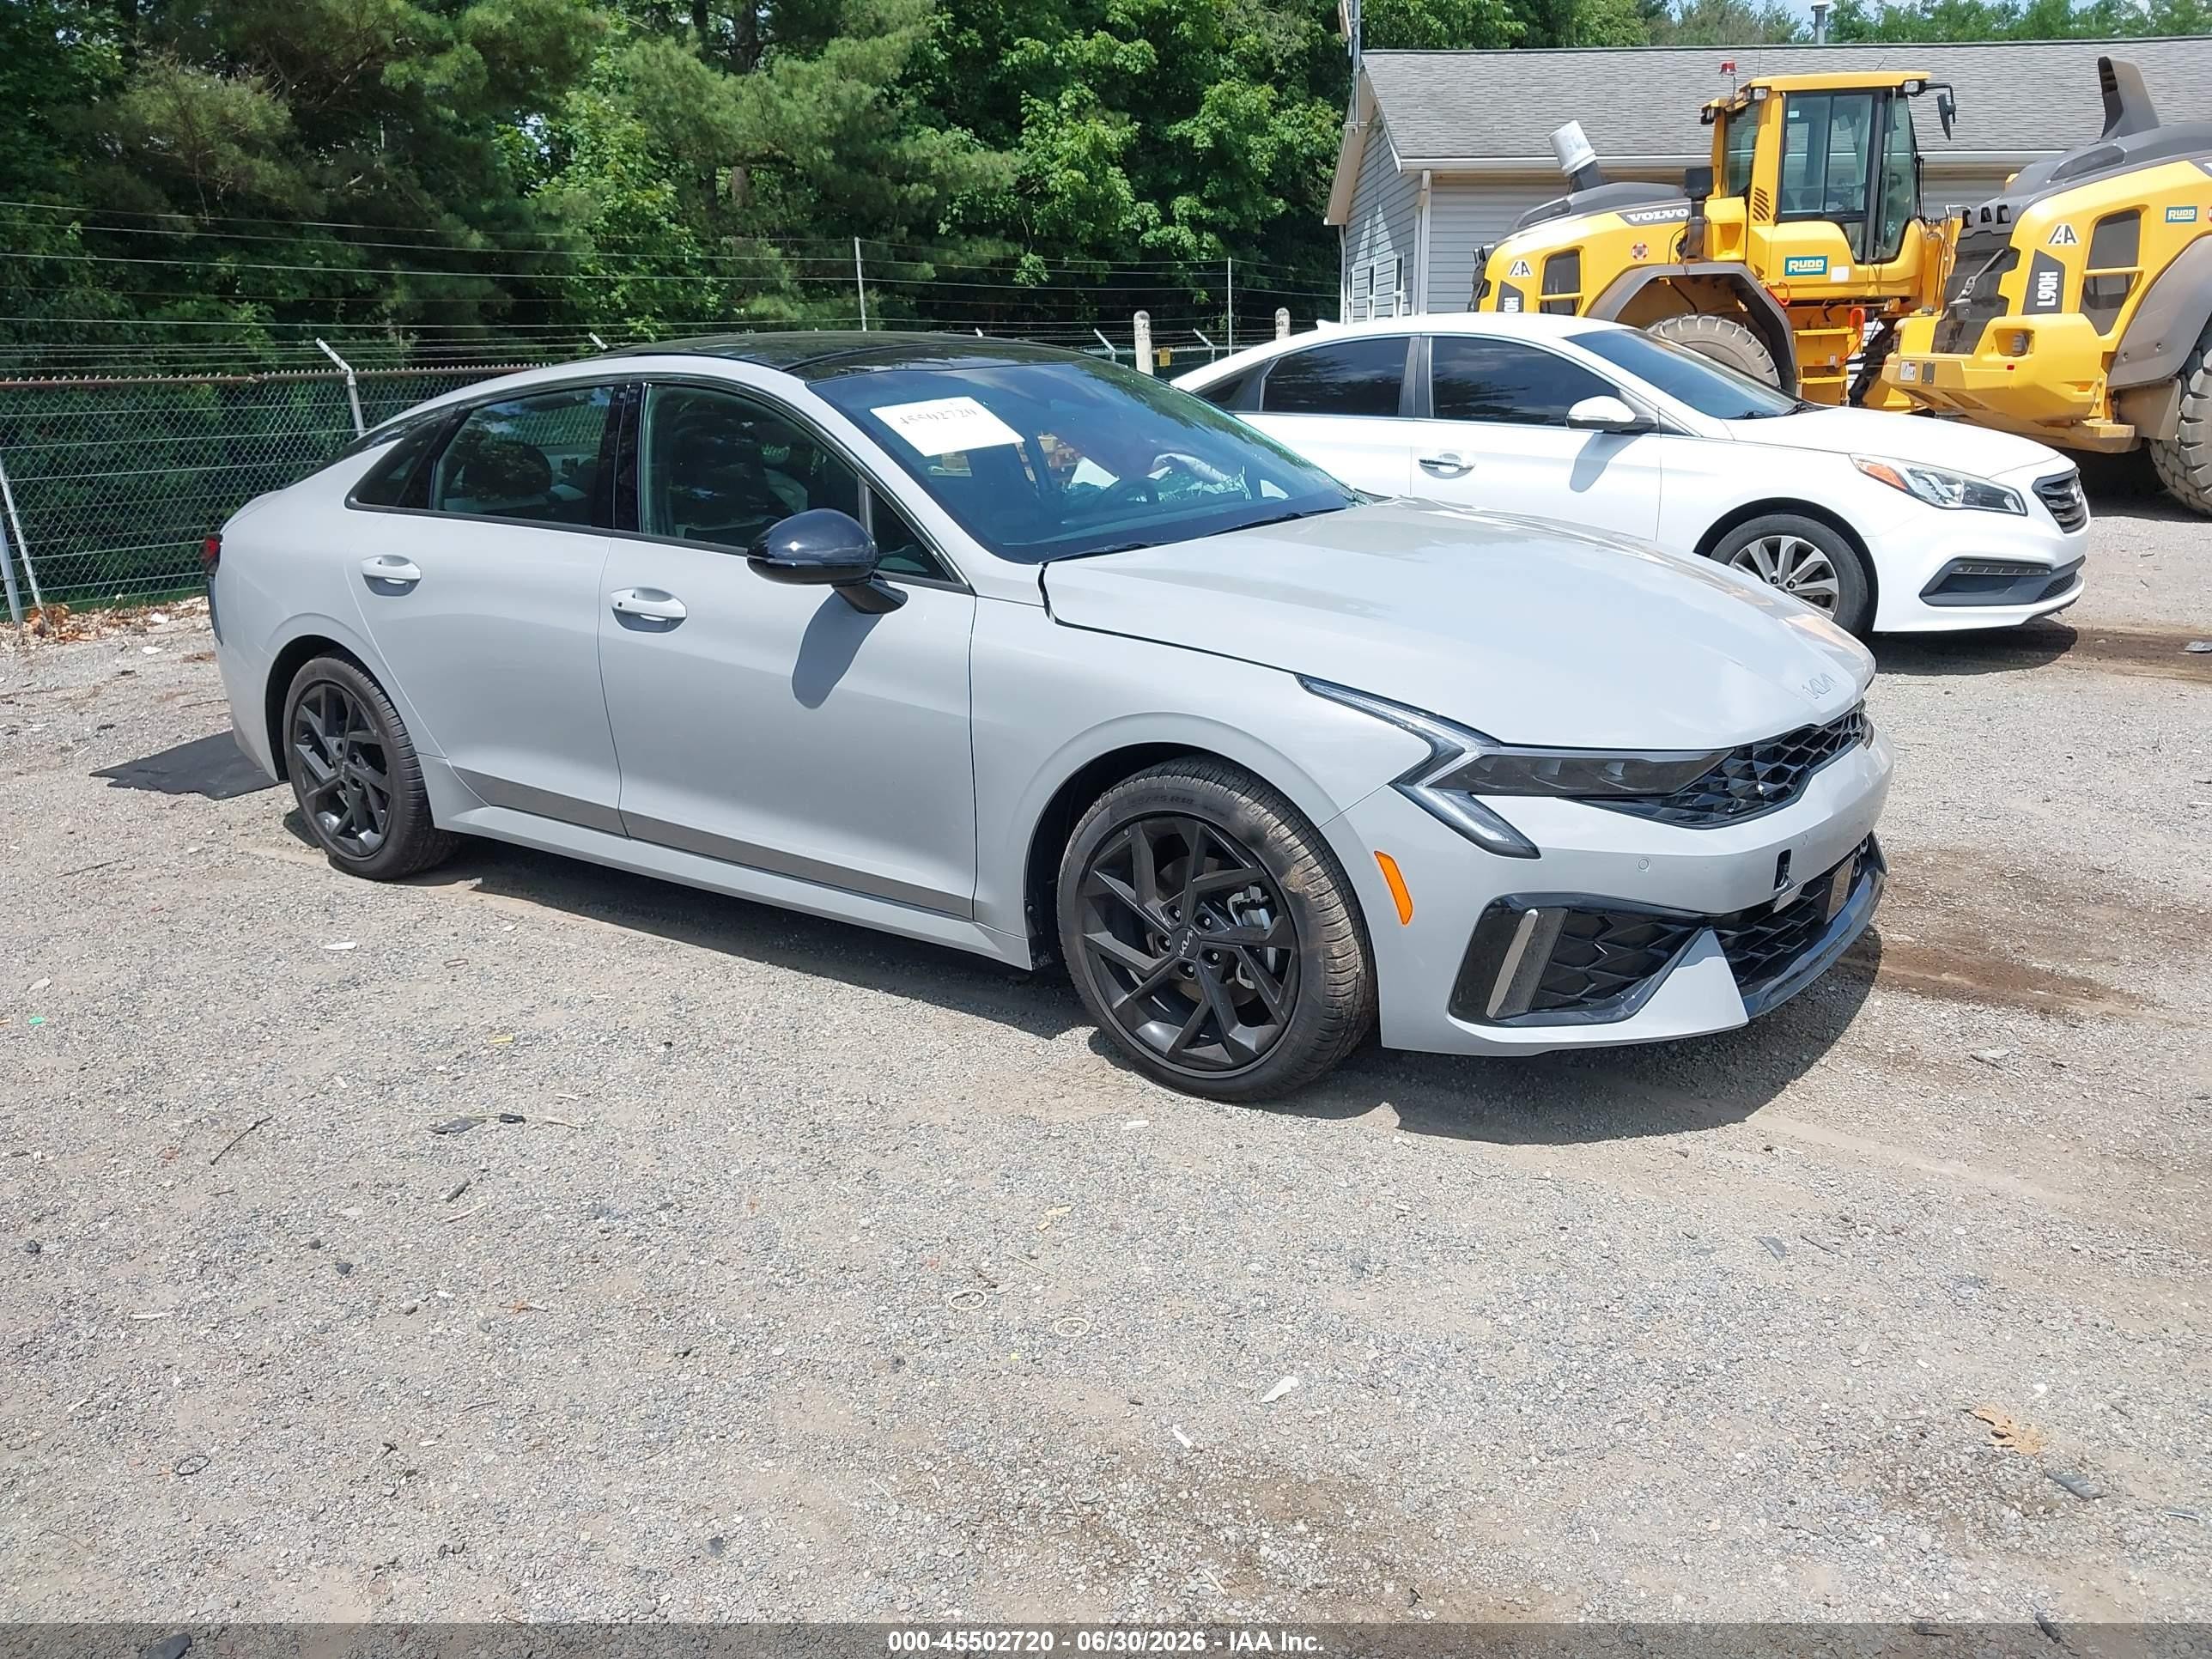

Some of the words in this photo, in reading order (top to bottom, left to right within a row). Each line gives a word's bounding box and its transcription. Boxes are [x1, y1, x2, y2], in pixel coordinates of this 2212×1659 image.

[1626, 208, 1689, 222] VOLVO
[2168, 209, 2196, 221] RUDD
[1788, 258, 1825, 273] RUDD
[2036, 271, 2059, 307] L90H
